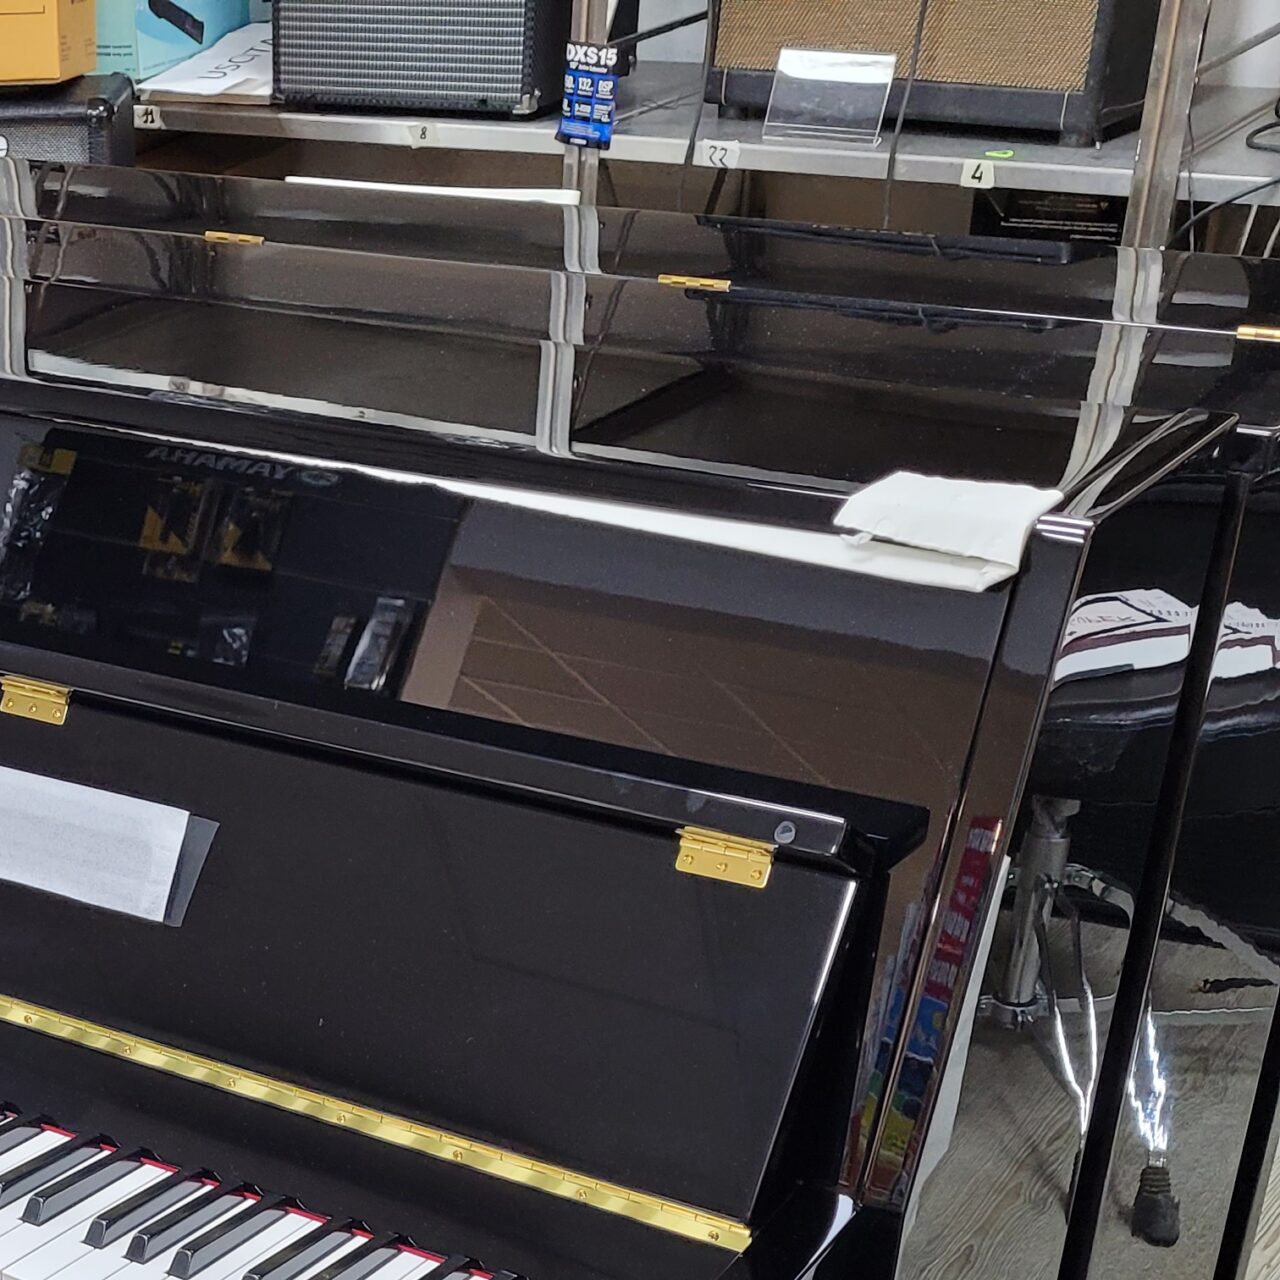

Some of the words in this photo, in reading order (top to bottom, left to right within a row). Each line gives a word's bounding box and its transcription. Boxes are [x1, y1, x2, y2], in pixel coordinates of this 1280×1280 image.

[566, 42, 618, 67] DXS15
[419, 125, 428, 140] 8
[971, 163, 984, 183] 4
